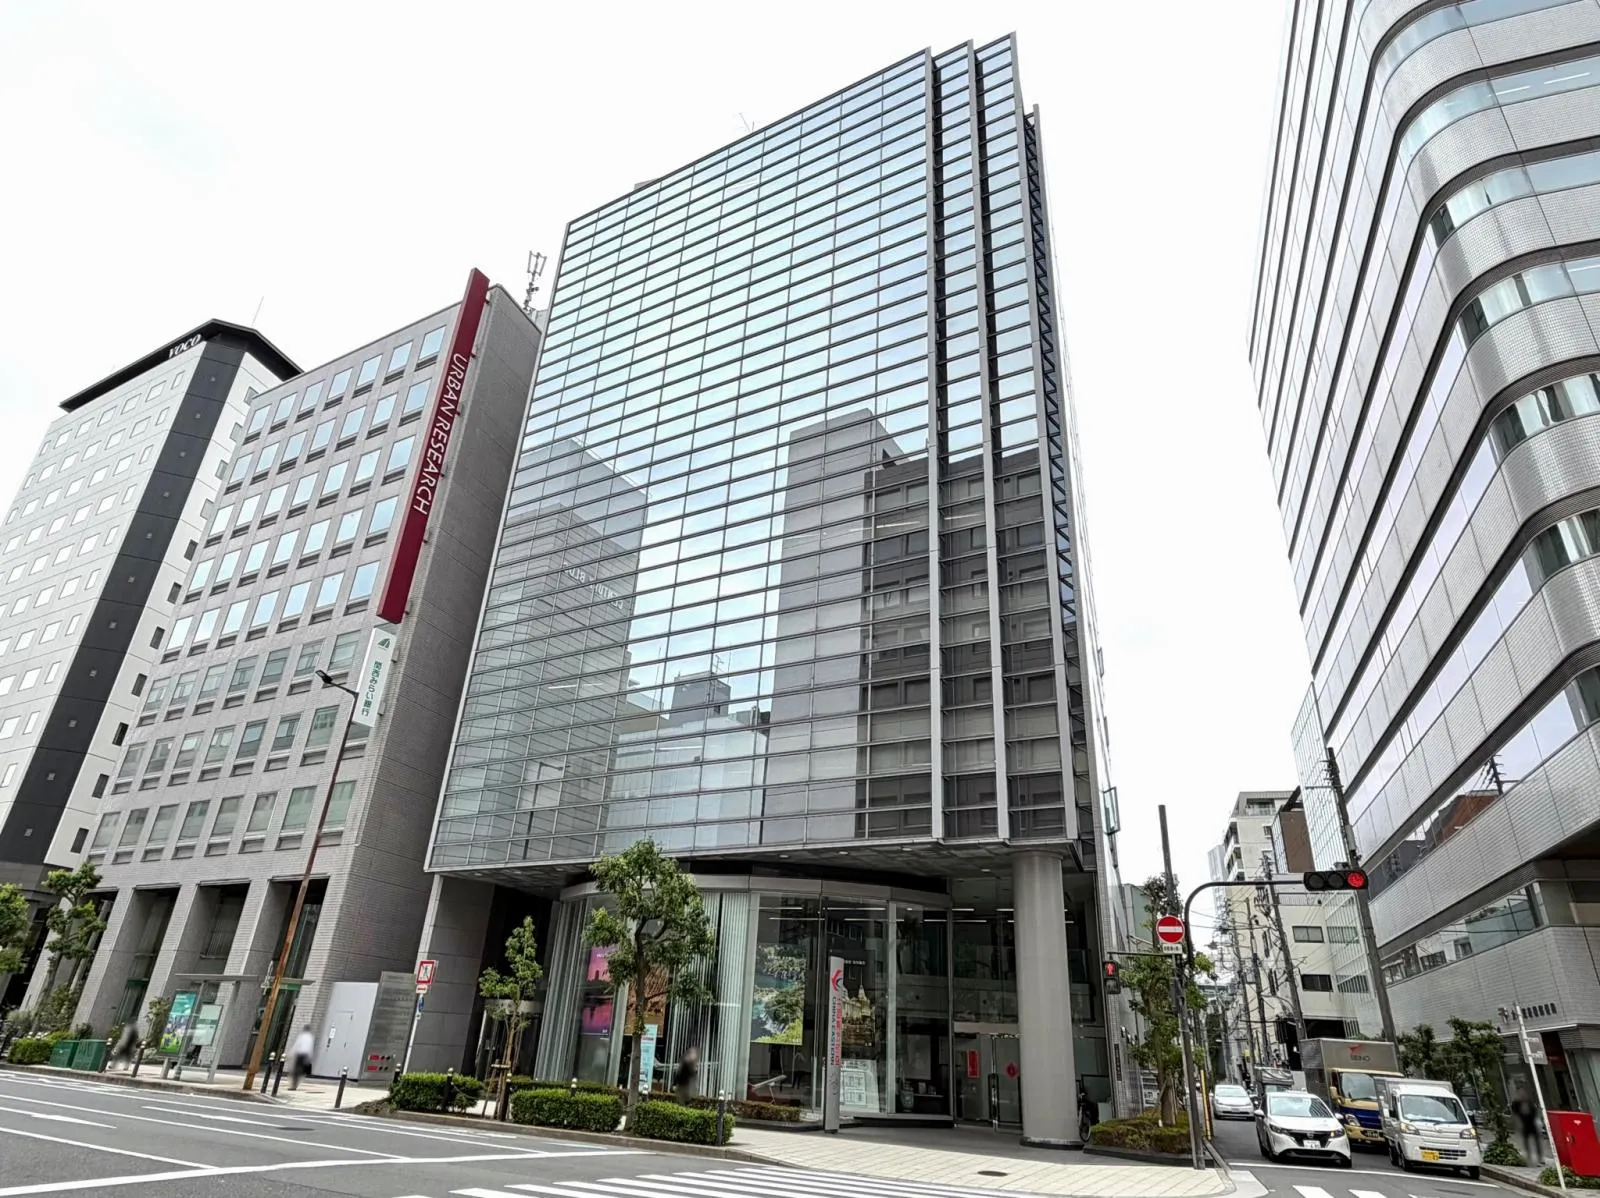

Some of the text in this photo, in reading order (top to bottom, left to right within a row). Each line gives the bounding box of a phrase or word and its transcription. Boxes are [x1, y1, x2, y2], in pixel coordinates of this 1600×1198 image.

[413, 353, 467, 515] URBAN RESEARCH
[361, 661, 382, 717] 関西みらい銀行
